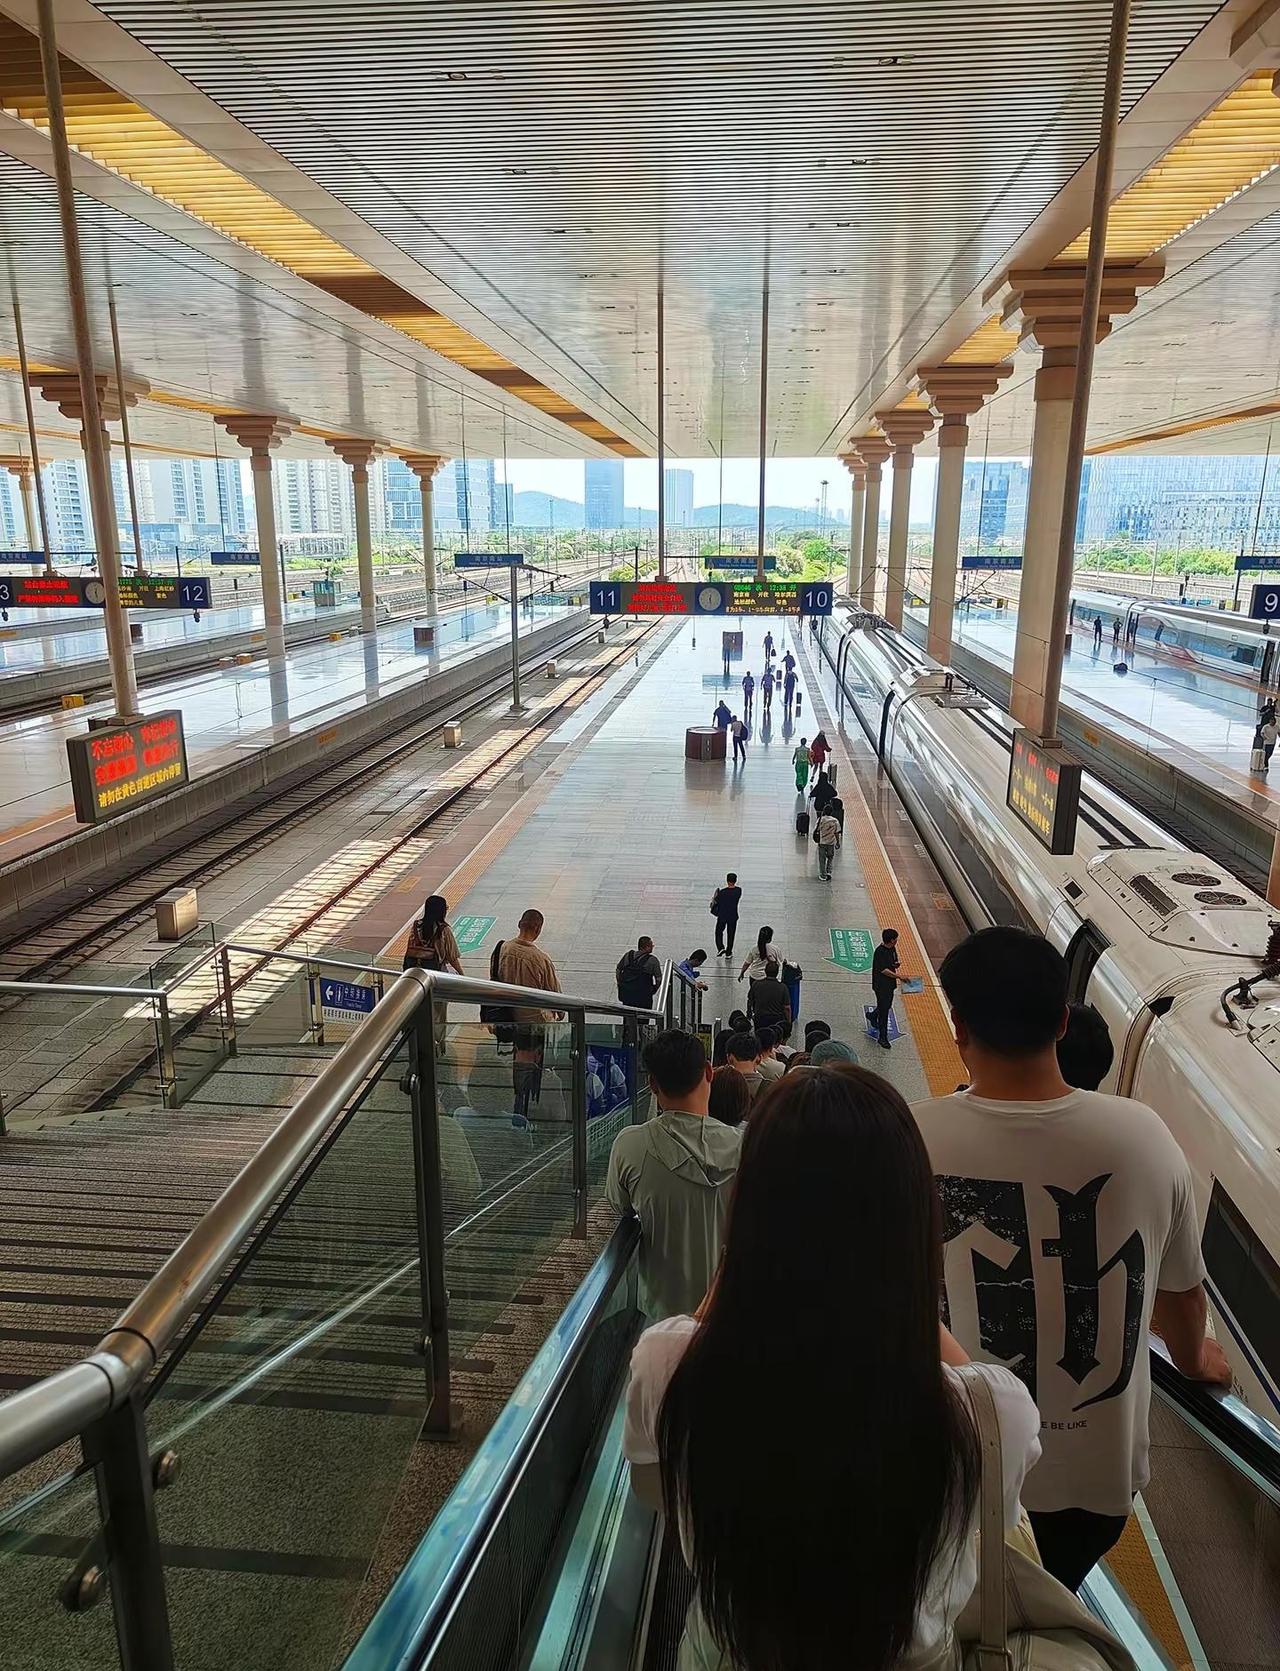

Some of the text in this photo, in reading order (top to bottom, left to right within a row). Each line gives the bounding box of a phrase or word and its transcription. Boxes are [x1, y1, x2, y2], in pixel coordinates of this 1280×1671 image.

[183, 585, 204, 601] 12
[597, 590, 616, 607] 11
[805, 591, 828, 608] 10
[1264, 593, 1279, 612] 9
[1051, 1422, 1065, 1430] BE
[1067, 1420, 1088, 1430] LIKE
